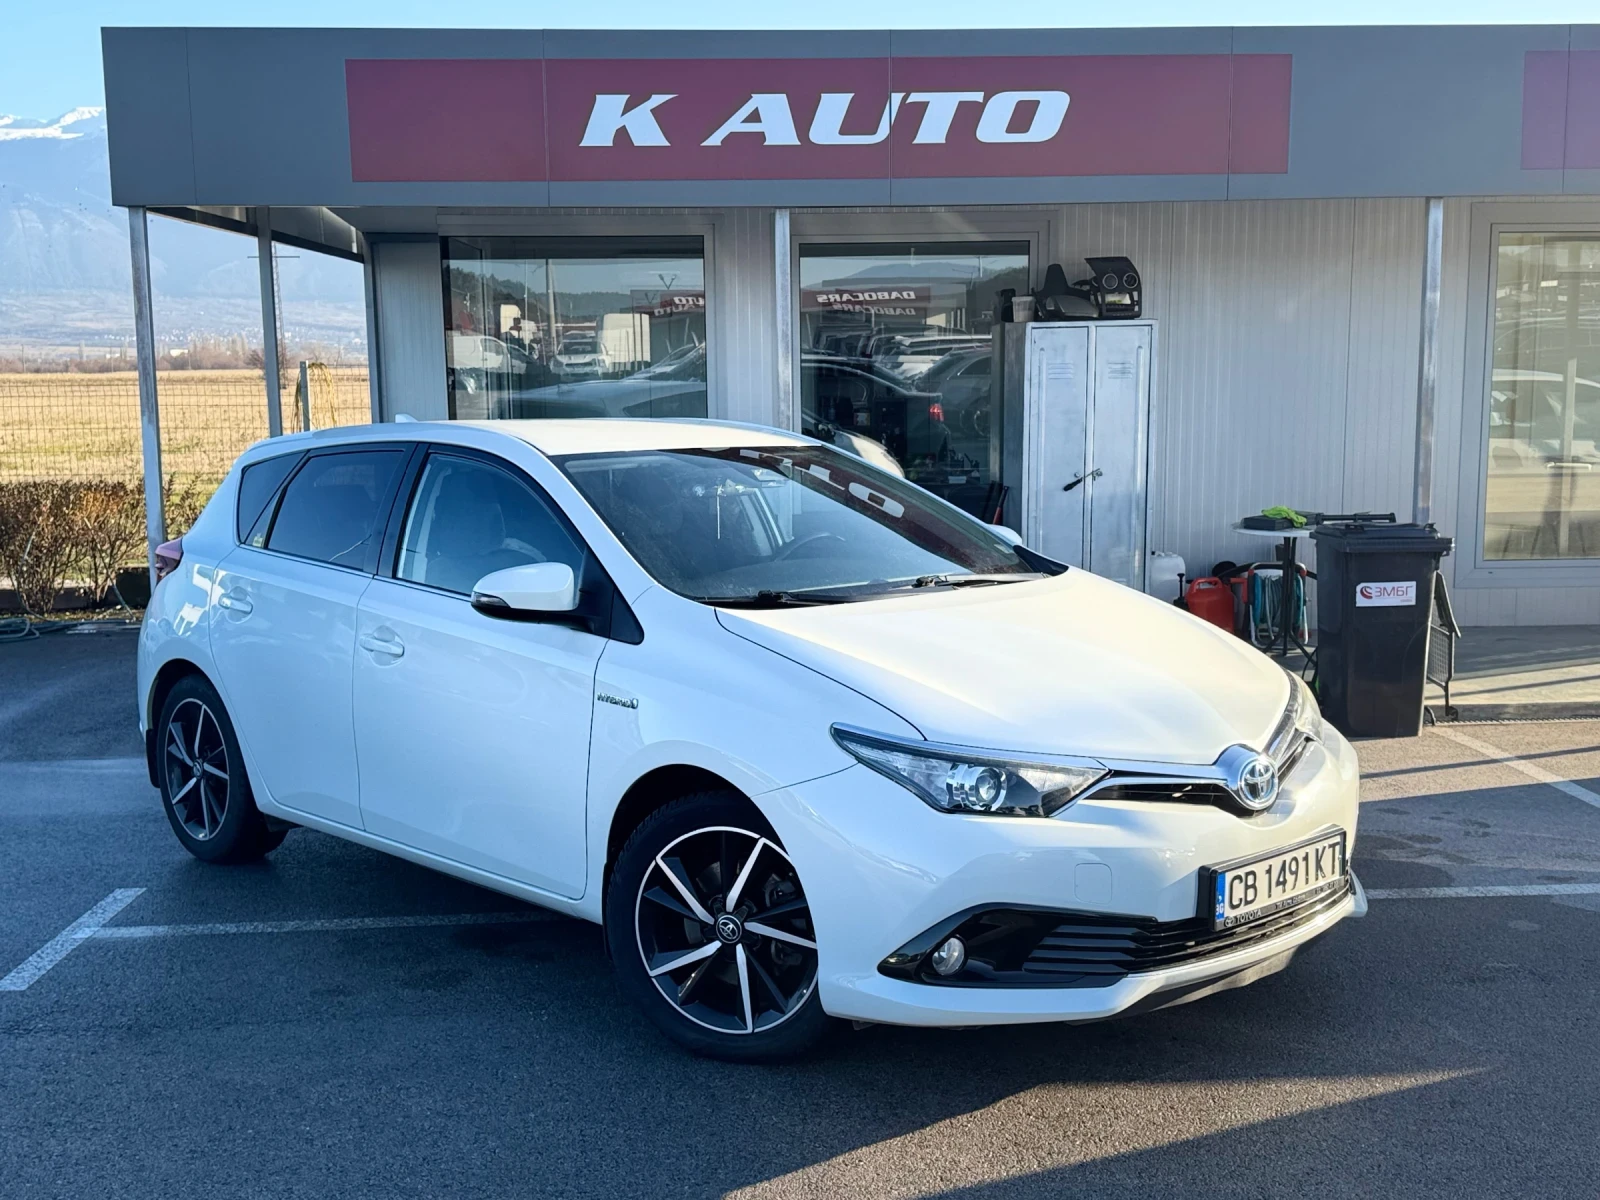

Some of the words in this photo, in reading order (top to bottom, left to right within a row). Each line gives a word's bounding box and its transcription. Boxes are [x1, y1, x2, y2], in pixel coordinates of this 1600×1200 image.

[578, 93, 680, 147] K
[699, 90, 1071, 147] AUTO
[1374, 585, 1414, 598] ЗМБГ
[1228, 869, 1258, 910] CB
[1265, 851, 1310, 899] 1491
[1314, 841, 1340, 882] KT
[1235, 909, 1263, 924] TOYOTA
